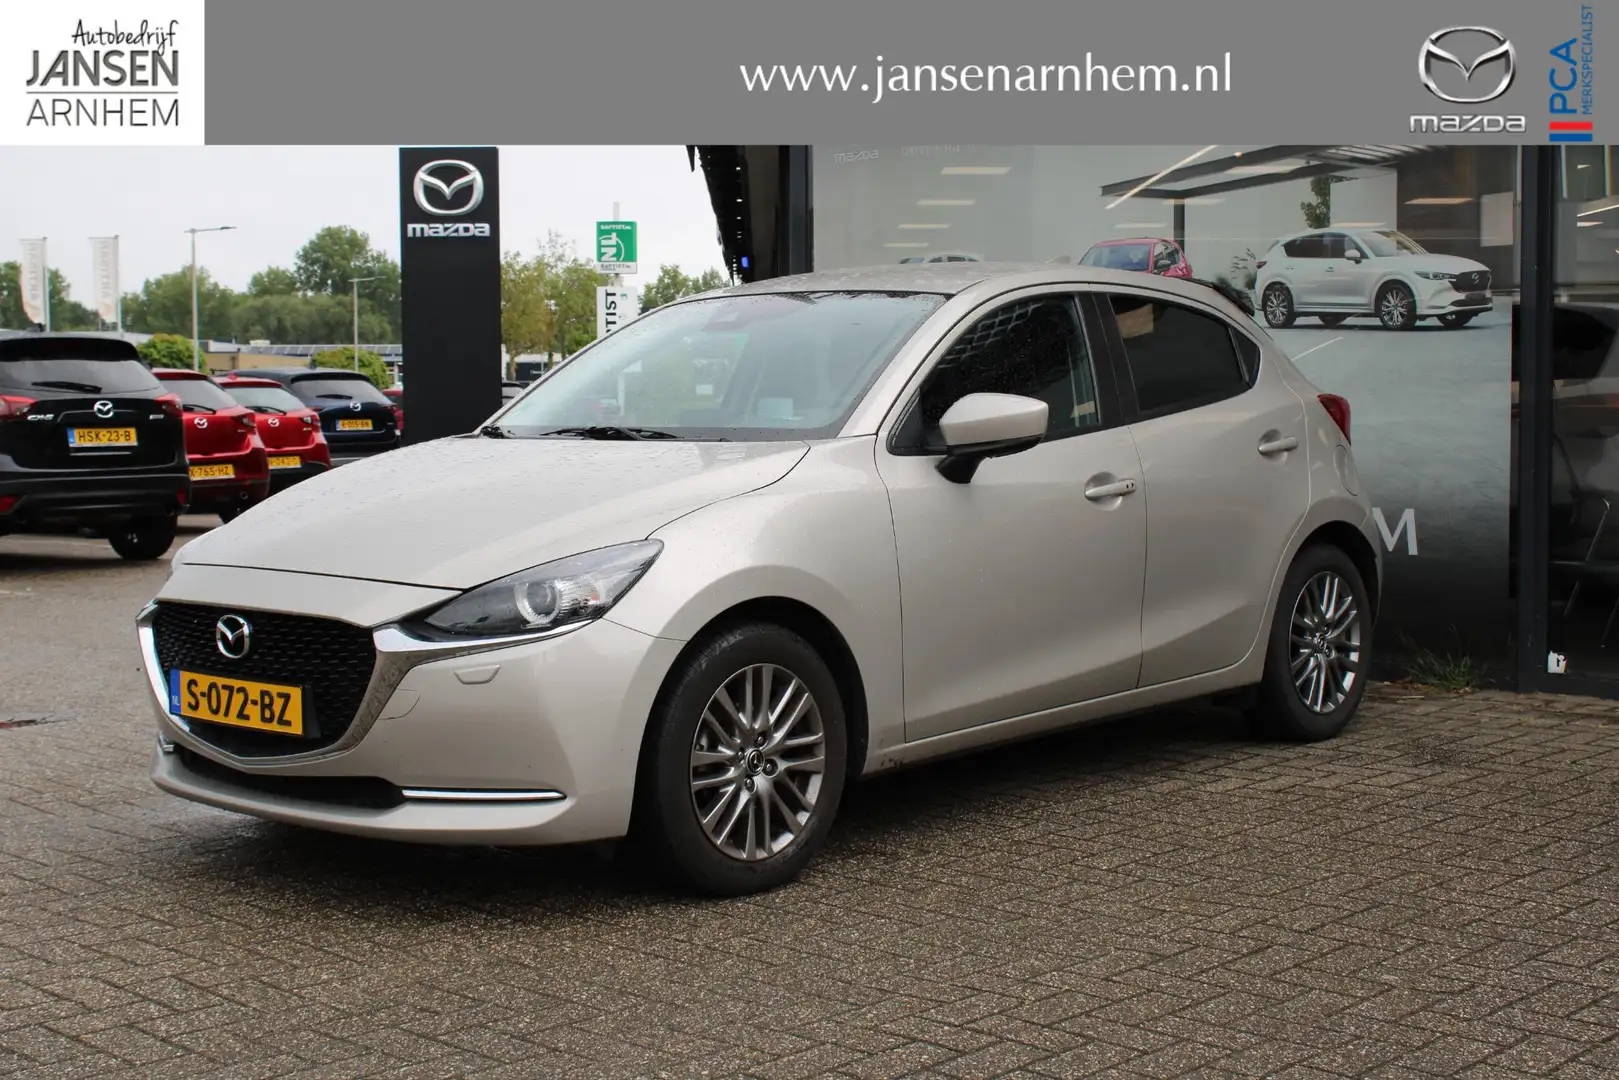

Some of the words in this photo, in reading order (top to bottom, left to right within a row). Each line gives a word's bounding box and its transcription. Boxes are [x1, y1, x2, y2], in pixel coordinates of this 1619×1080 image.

[406, 222, 491, 238] mazda
[605, 289, 617, 333] TIST
[78, 430, 131, 443] HSK-23-B
[186, 678, 292, 727] S-072-BZ
